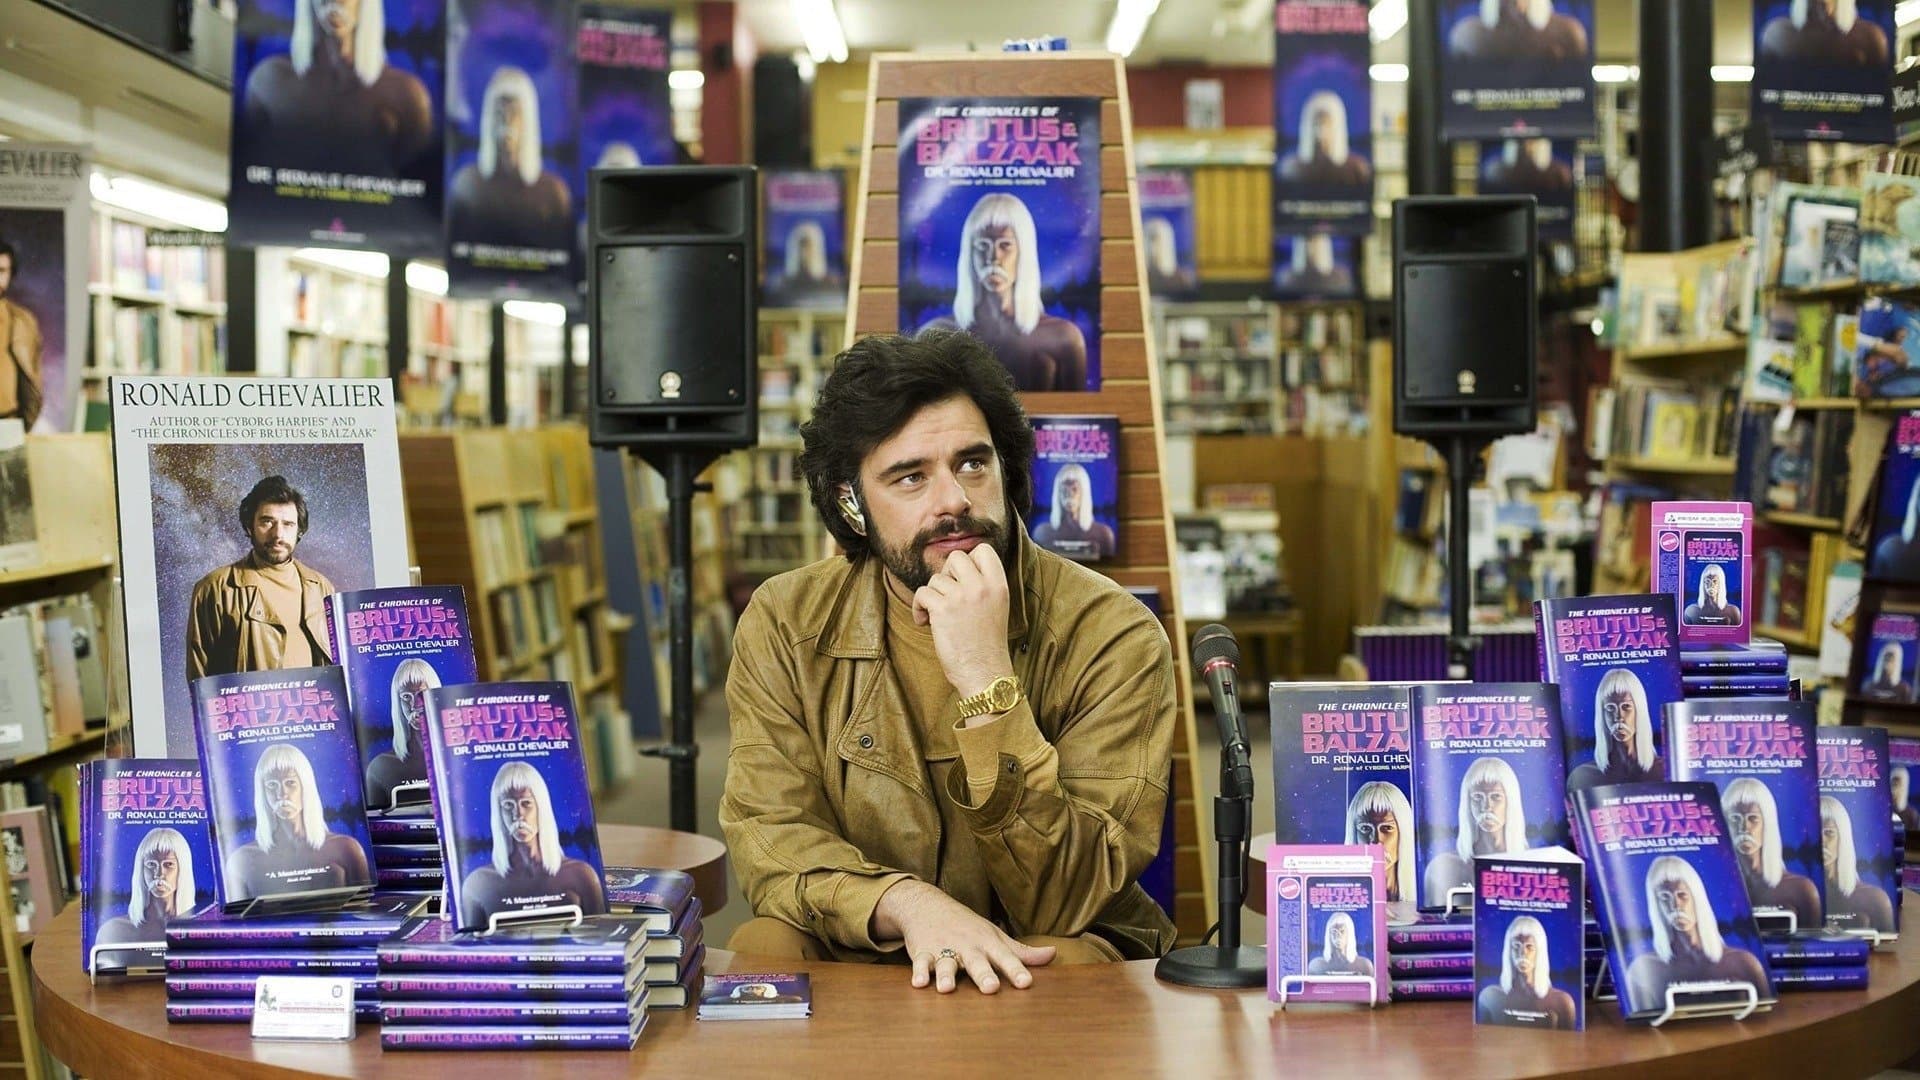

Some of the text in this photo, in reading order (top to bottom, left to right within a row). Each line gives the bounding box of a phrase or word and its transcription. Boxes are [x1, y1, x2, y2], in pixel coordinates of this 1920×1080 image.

[935, 107, 1059, 117] THE CHRONICLES OF
[917, 118, 1060, 142] BRUTUS
[917, 142, 1082, 166] BALZAAK
[950, 166, 1003, 178] RONALD
[1006, 166, 1075, 178] CHEVALIER
[120, 383, 385, 407] RONALD CHEVALIER
[150, 416, 202, 427] AUTHOR
[204, 416, 220, 427] OF
[331, 416, 356, 427] AND
[162, 428, 239, 439] CHRONICLES
[241, 428, 257, 439] OF
[260, 428, 306, 439] BRUTUS
[307, 429, 318, 439] &
[1687, 541, 1733, 549] BRUTUS
[1687, 549, 1739, 557] BALZAAK
[359, 602, 376, 610] THE
[378, 598, 430, 609] CHRONICLES
[1587, 607, 1640, 616] CHRONICLES
[1641, 606, 1653, 614] OF
[347, 605, 446, 629] BRUTUS
[1556, 614, 1655, 637] BRUTUS
[349, 622, 462, 646] BALZAAK
[358, 639, 459, 654] DR. RONALD CHEVALIER
[1557, 631, 1671, 654] BALZAAK
[1564, 649, 1667, 662] DR. RONALD CHEVALIER
[220, 680, 317, 696] THE CHRONICLES OF
[207, 689, 320, 716] BRUTUS
[454, 694, 550, 706] THE CHRONICLES OF
[1317, 702, 1408, 711] THE CHRONICLES
[210, 704, 339, 733] BALZAAK
[441, 704, 553, 728] BRUTUS
[1422, 704, 1533, 723] BRUTUS
[1714, 714, 1773, 722] CHRONICLES
[1302, 712, 1409, 733] BRUTU
[218, 722, 335, 741] DR. RONALD CHEVALIER
[444, 721, 573, 746] BALZAAK
[1423, 722, 1552, 740] BALZAAK
[1686, 723, 1790, 741] BRUTUS
[453, 740, 568, 755] DR. RONALD CHEVALIER
[1303, 732, 1410, 753] BALZA
[1430, 739, 1546, 749] DR. RONALD CHEVALIER
[1686, 741, 1807, 759] BALZAAK
[1311, 755, 1330, 764] DR.
[1333, 754, 1380, 764] RONALD
[1817, 745, 1864, 762] TUS
[1687, 759, 1803, 768] DR. RONALD CHEVALIER
[1818, 762, 1880, 779] ZAAK
[136, 770, 192, 778] CHRONICLES
[102, 778, 203, 795] BRUTUS
[1826, 779, 1876, 787] CHEVALIER
[102, 795, 206, 811] BALZAA
[1623, 795, 1681, 804] CHRONICLES
[127, 811, 166, 819] RONALD
[169, 811, 208, 819] CHEVALI
[1590, 802, 1700, 827] BRUTUS
[1594, 819, 1721, 844] BALZAAK
[1605, 836, 1719, 852] DR. RONALD CHEVALIER
[1482, 872, 1560, 889] BRUTUS
[1482, 885, 1571, 902] BALZAAK
[1411, 933, 1457, 942] BRUTUS
[187, 960, 233, 969] BRUTUS
[240, 960, 292, 969] BALZAAK
